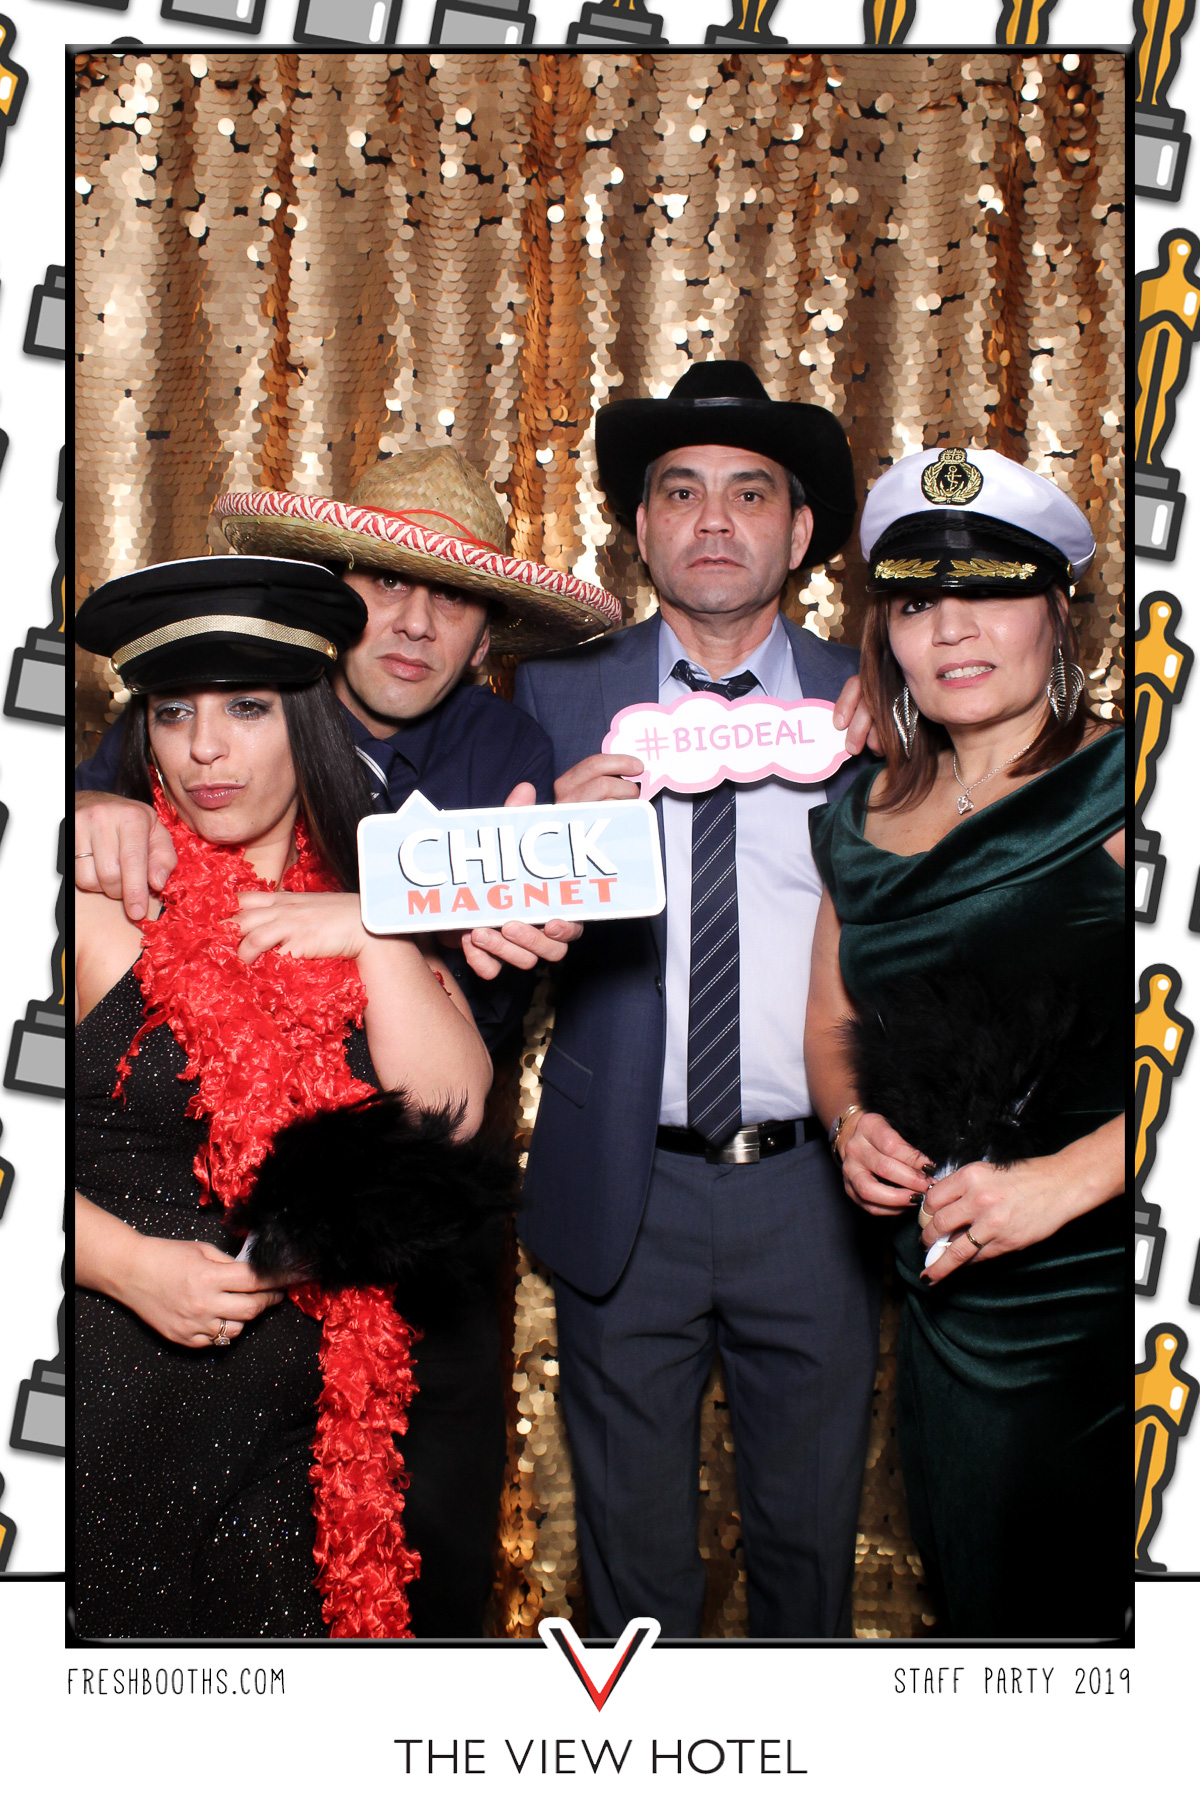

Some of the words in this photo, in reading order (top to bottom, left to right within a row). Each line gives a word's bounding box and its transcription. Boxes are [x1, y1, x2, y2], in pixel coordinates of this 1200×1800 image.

[634, 719, 815, 761] #BIGDEAL
[398, 818, 618, 887] CHICK
[408, 878, 617, 915] MAGNET
